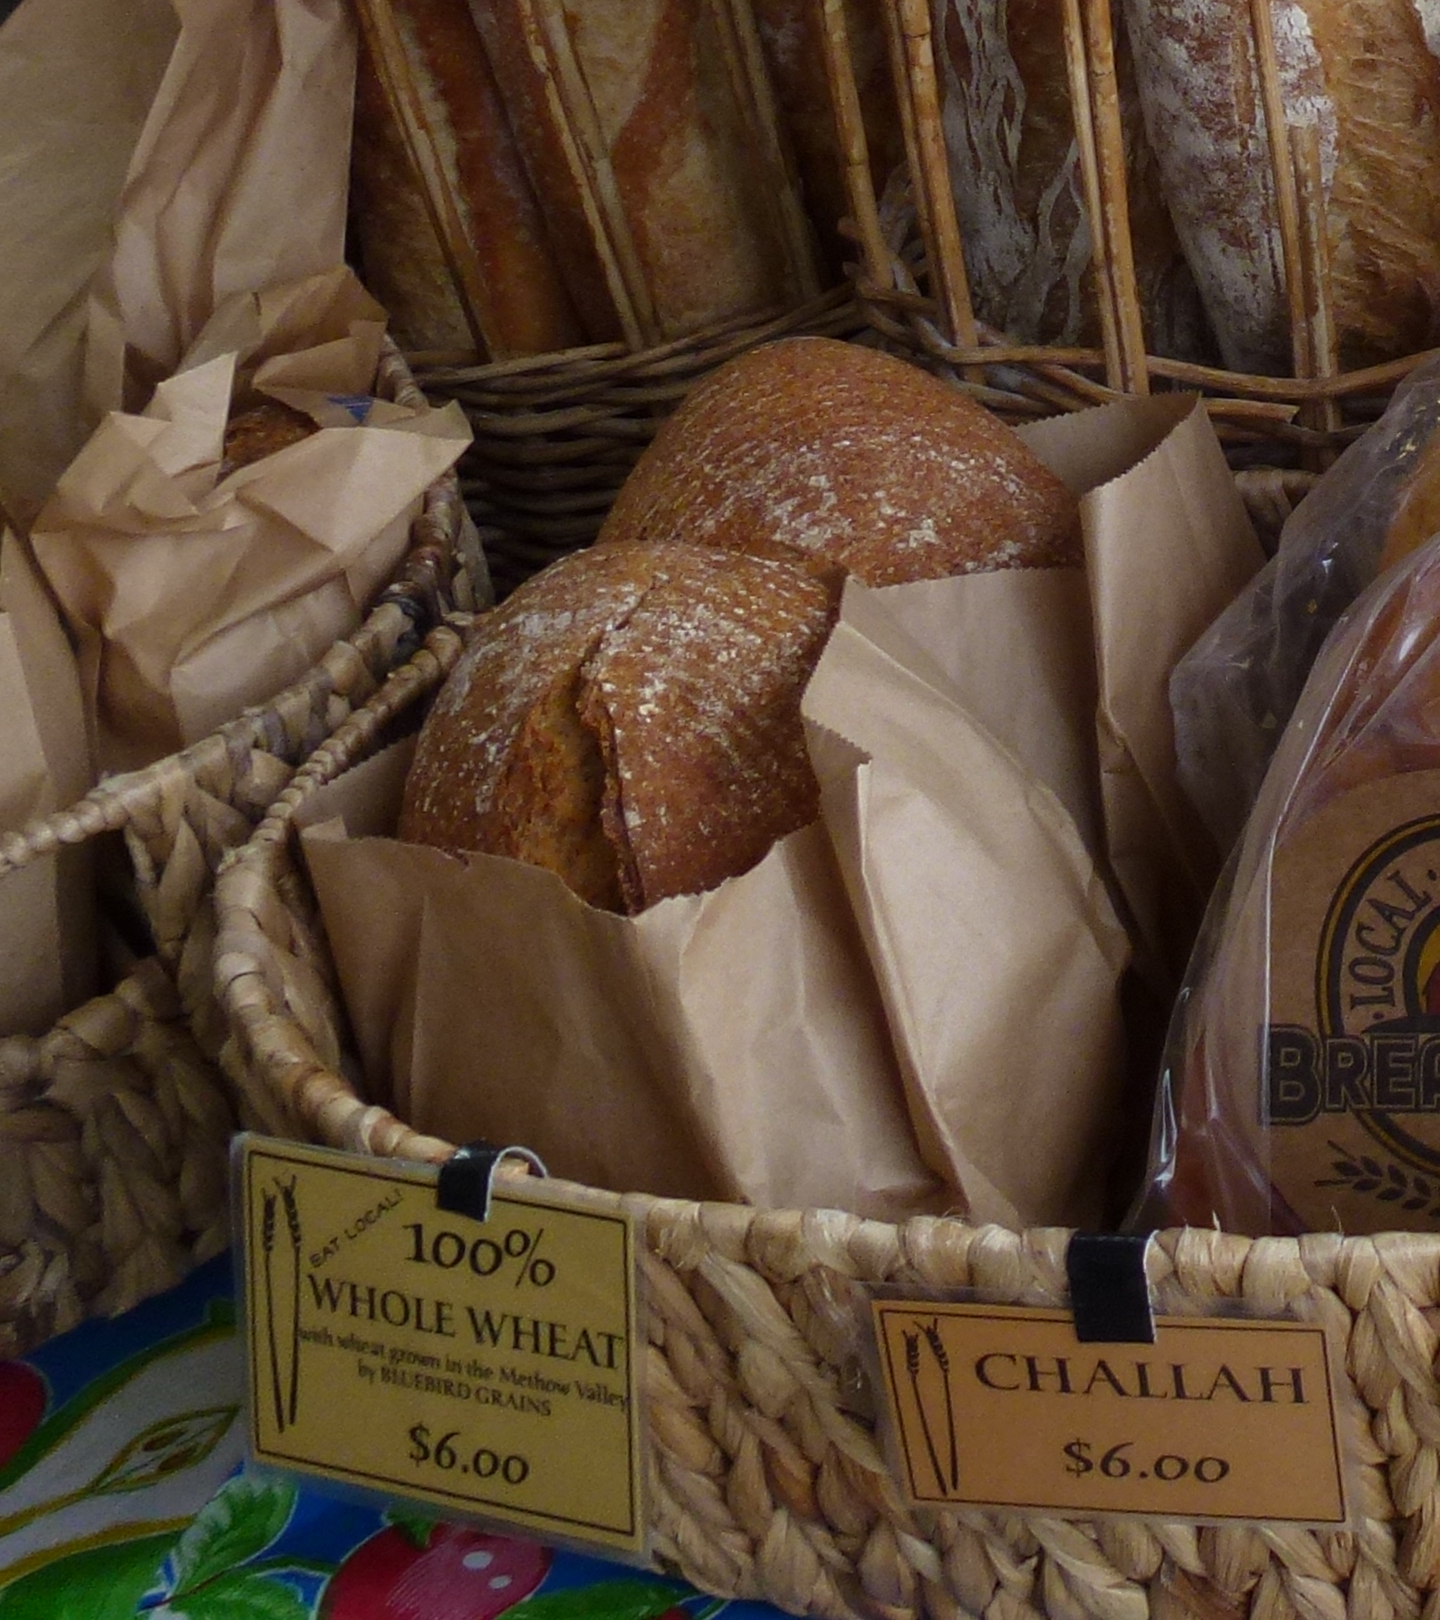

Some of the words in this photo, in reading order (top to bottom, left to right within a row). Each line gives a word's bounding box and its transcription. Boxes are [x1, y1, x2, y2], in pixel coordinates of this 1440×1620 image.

[1349, 868, 1433, 1011] LOCAL
[308, 1235, 341, 1269] EAT
[401, 1220, 558, 1290] 100%
[307, 1272, 457, 1339] WHOLE
[464, 1304, 625, 1372] WHEAT
[337, 1332, 386, 1360] wheat
[388, 1346, 442, 1371] grown
[444, 1353, 464, 1374] in
[465, 1357, 494, 1381] the
[574, 1379, 630, 1413] Valley
[356, 1357, 377, 1386] by
[379, 1364, 472, 1401] BLUEBIRD
[473, 1385, 553, 1418] GRAINS
[974, 1351, 1310, 1405] CHALLAH
[408, 1422, 531, 1485] $6.00
[1062, 1438, 1231, 1484] $6.00
